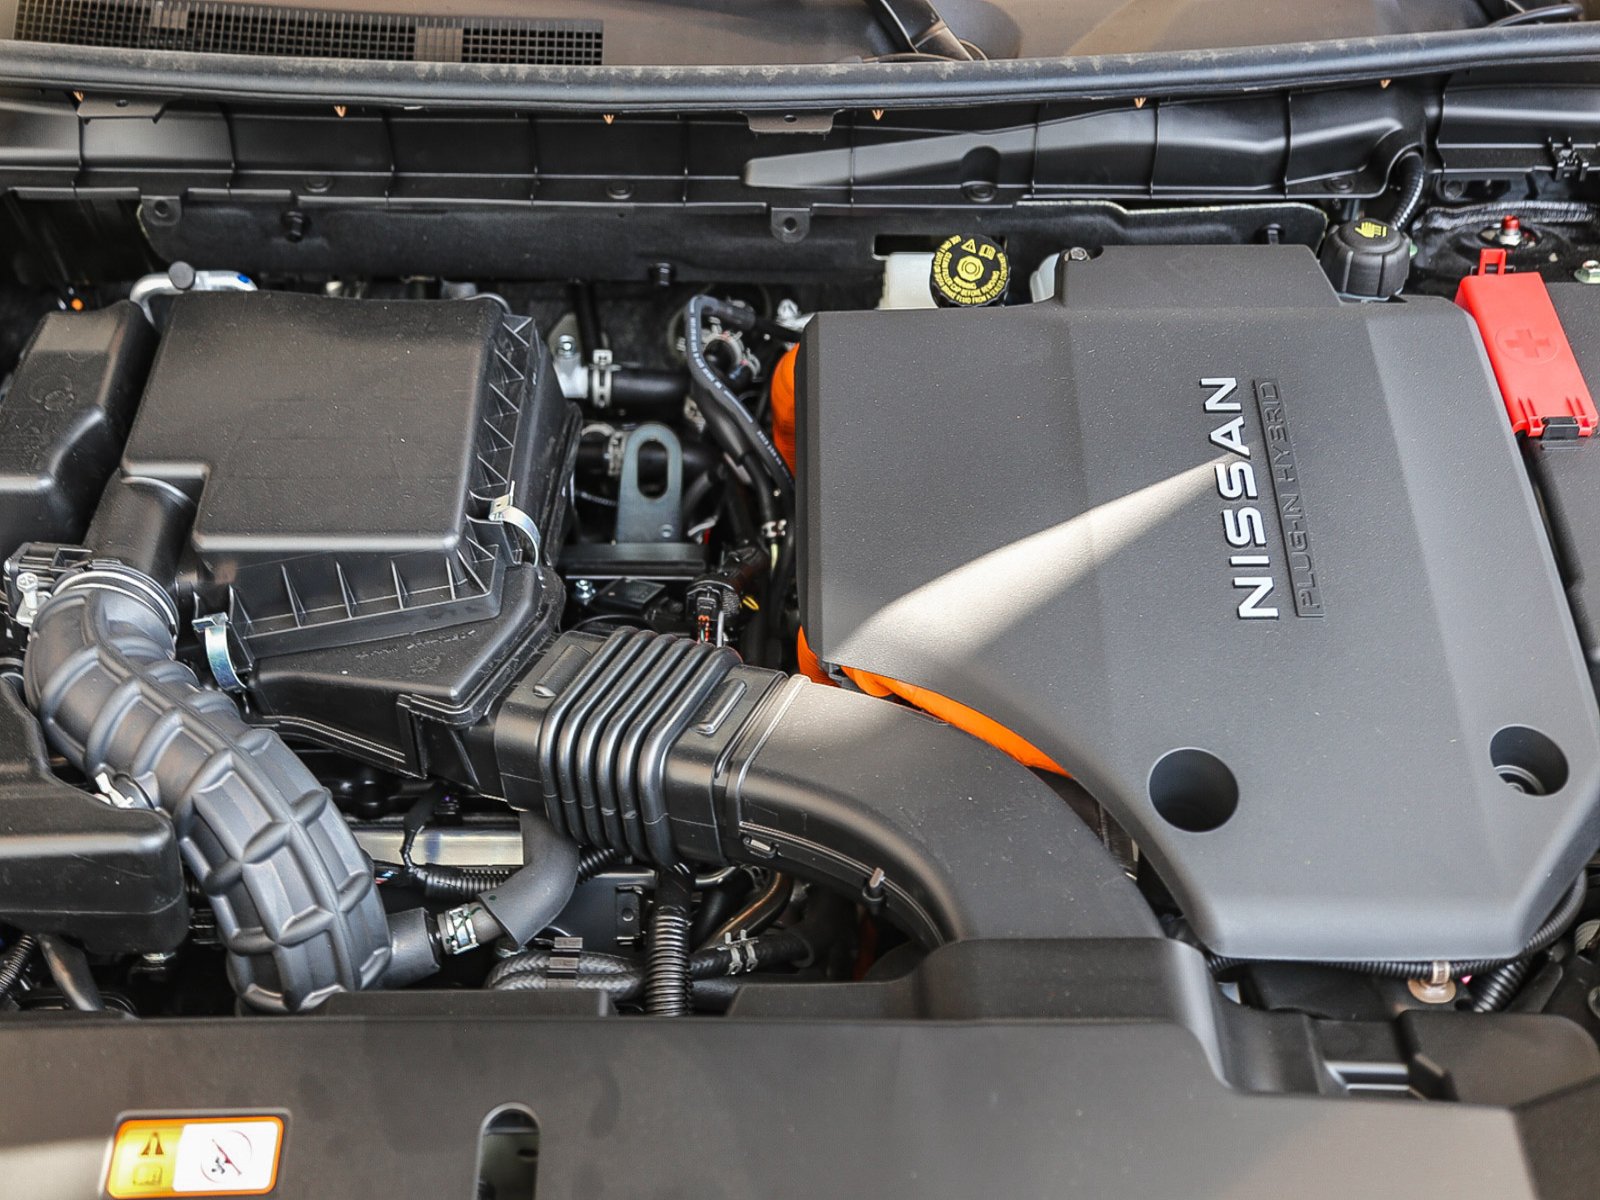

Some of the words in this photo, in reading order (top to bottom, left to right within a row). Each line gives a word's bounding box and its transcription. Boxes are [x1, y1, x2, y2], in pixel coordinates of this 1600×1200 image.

[950, 283, 961, 293] CAP
[1259, 381, 1295, 483] HYBRID
[1200, 377, 1280, 620] NISSAN
[1280, 493, 1321, 610] PLUG-IN
